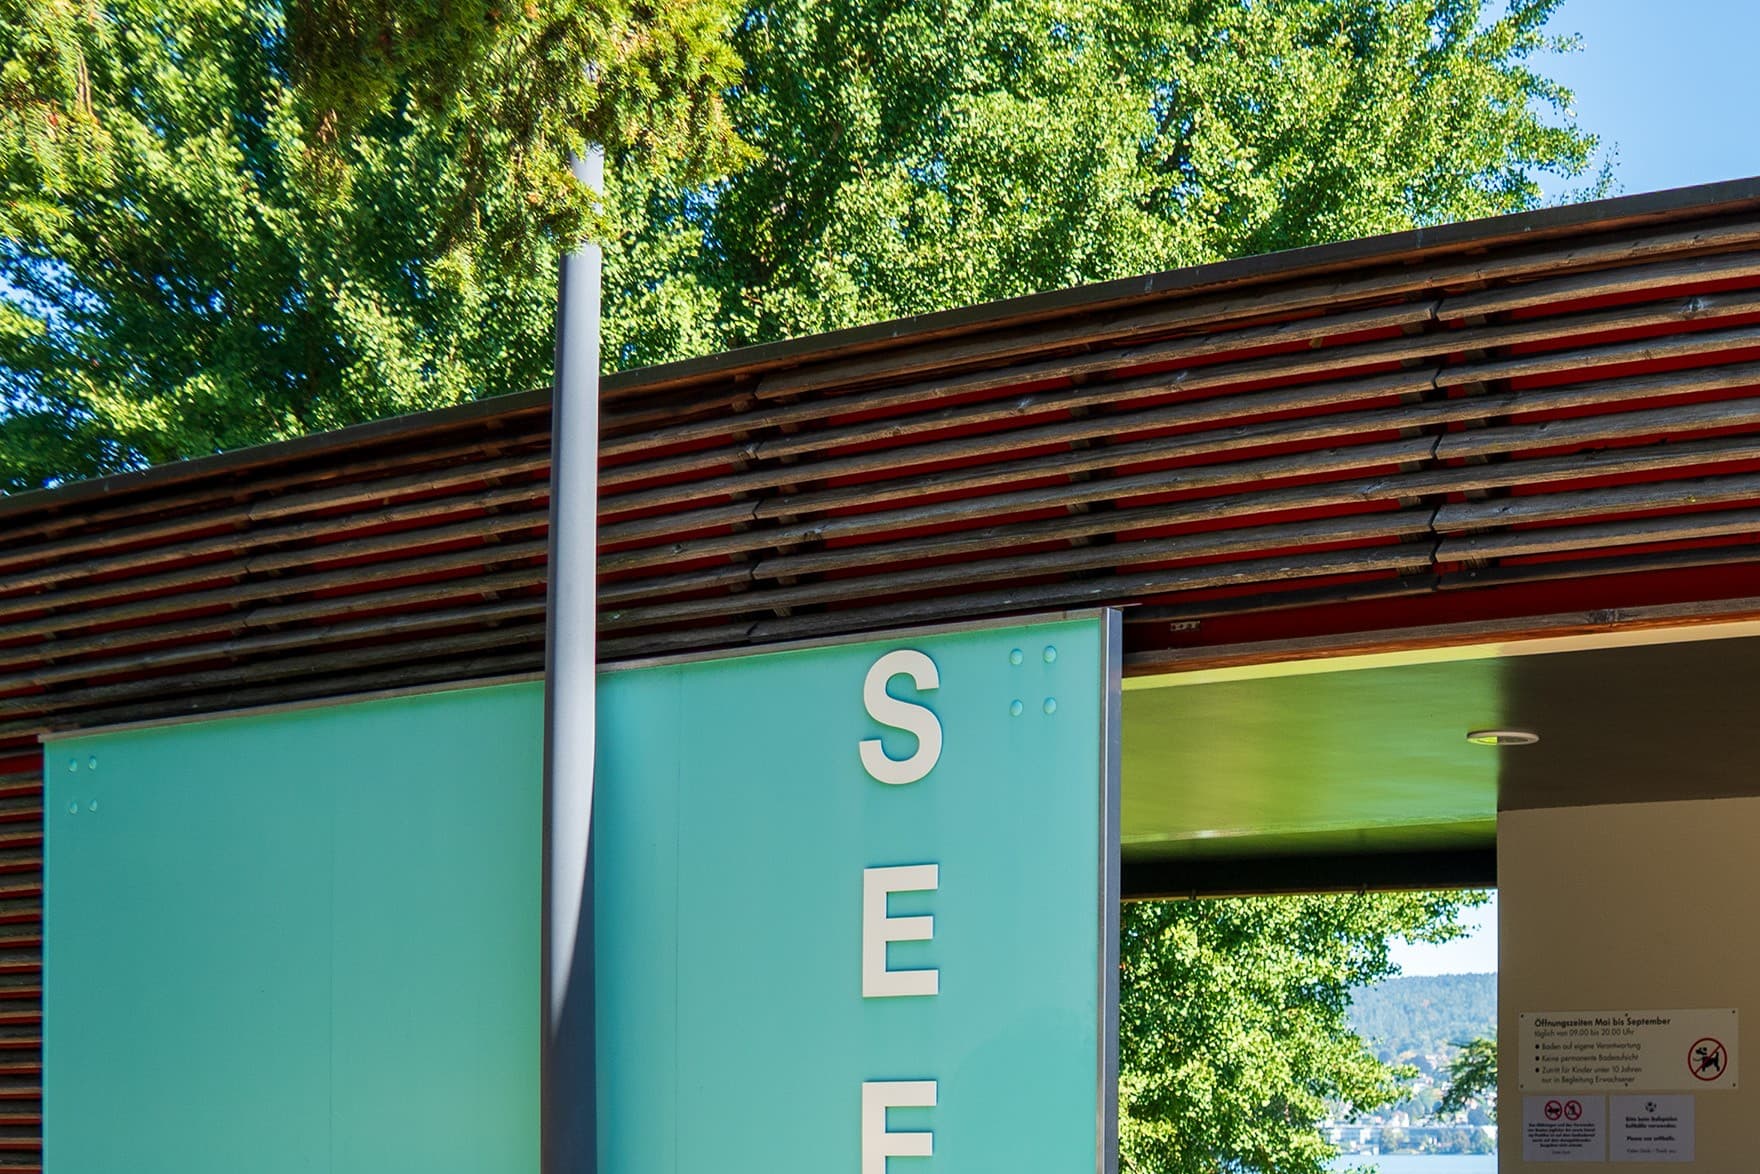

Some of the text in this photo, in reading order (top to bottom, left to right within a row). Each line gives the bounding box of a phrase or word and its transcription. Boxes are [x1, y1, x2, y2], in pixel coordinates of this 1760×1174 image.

[1534, 1016, 1671, 1028] Öffnungszeiten Mai bis September
